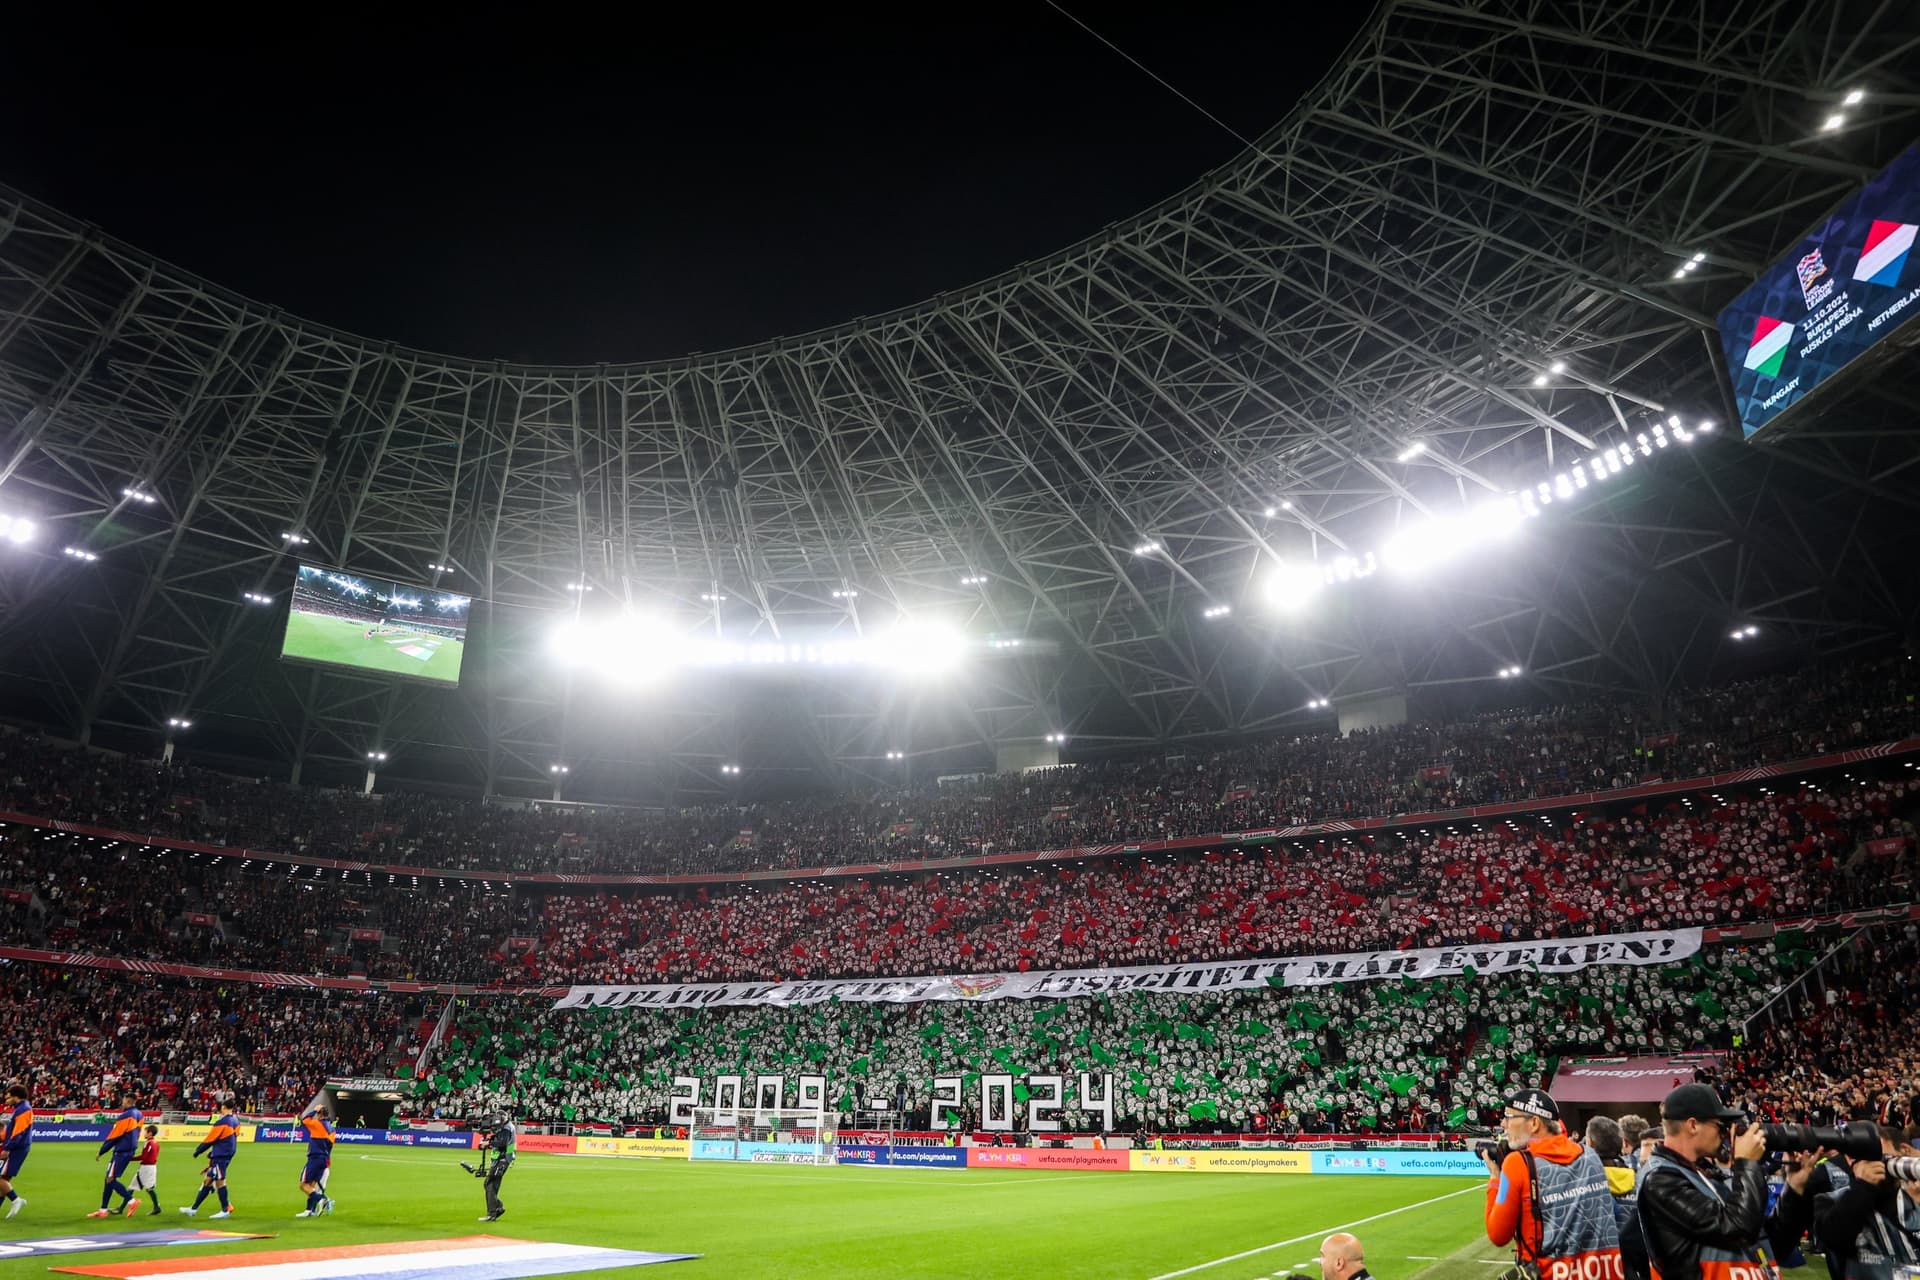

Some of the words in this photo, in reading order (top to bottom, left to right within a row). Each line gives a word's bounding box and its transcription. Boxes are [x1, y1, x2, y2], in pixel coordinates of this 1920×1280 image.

[1807, 278, 1834, 304] NATIONS
[1807, 288, 1832, 311] LEAGUE
[1803, 291, 1848, 331] 11.10.2024
[1806, 302, 1849, 341] BUDAPEST
[1800, 328, 1833, 358] PUSKÁS
[1833, 307, 1864, 333] ARÉNA
[1762, 376, 1800, 410] HUNGARY
[568, 993, 595, 1006] A
[1023, 962, 1299, 993] ÁTSEGÍTETT
[1305, 953, 1420, 978] MÁR
[1436, 939, 1676, 969] ÉVEKEN!
[1571, 1067, 1697, 1078] #magyaro
[670, 1074, 828, 1128] 2009
[930, 1072, 1114, 1132] 2024
[1512, 1100, 1525, 1112] SAN
[31, 1129, 99, 1137] fa.com/playmakers
[1038, 1154, 1118, 1165] uefa.com/playmakers
[1210, 1157, 1298, 1167] uefa.com/playmakers
[1325, 1157, 1386, 1168] PLAYMAKERS
[1401, 1157, 1486, 1170] uefa.com/playmak
[1542, 1191, 1565, 1204] UEFA
[1552, 1255, 1623, 1280] PHOTO
